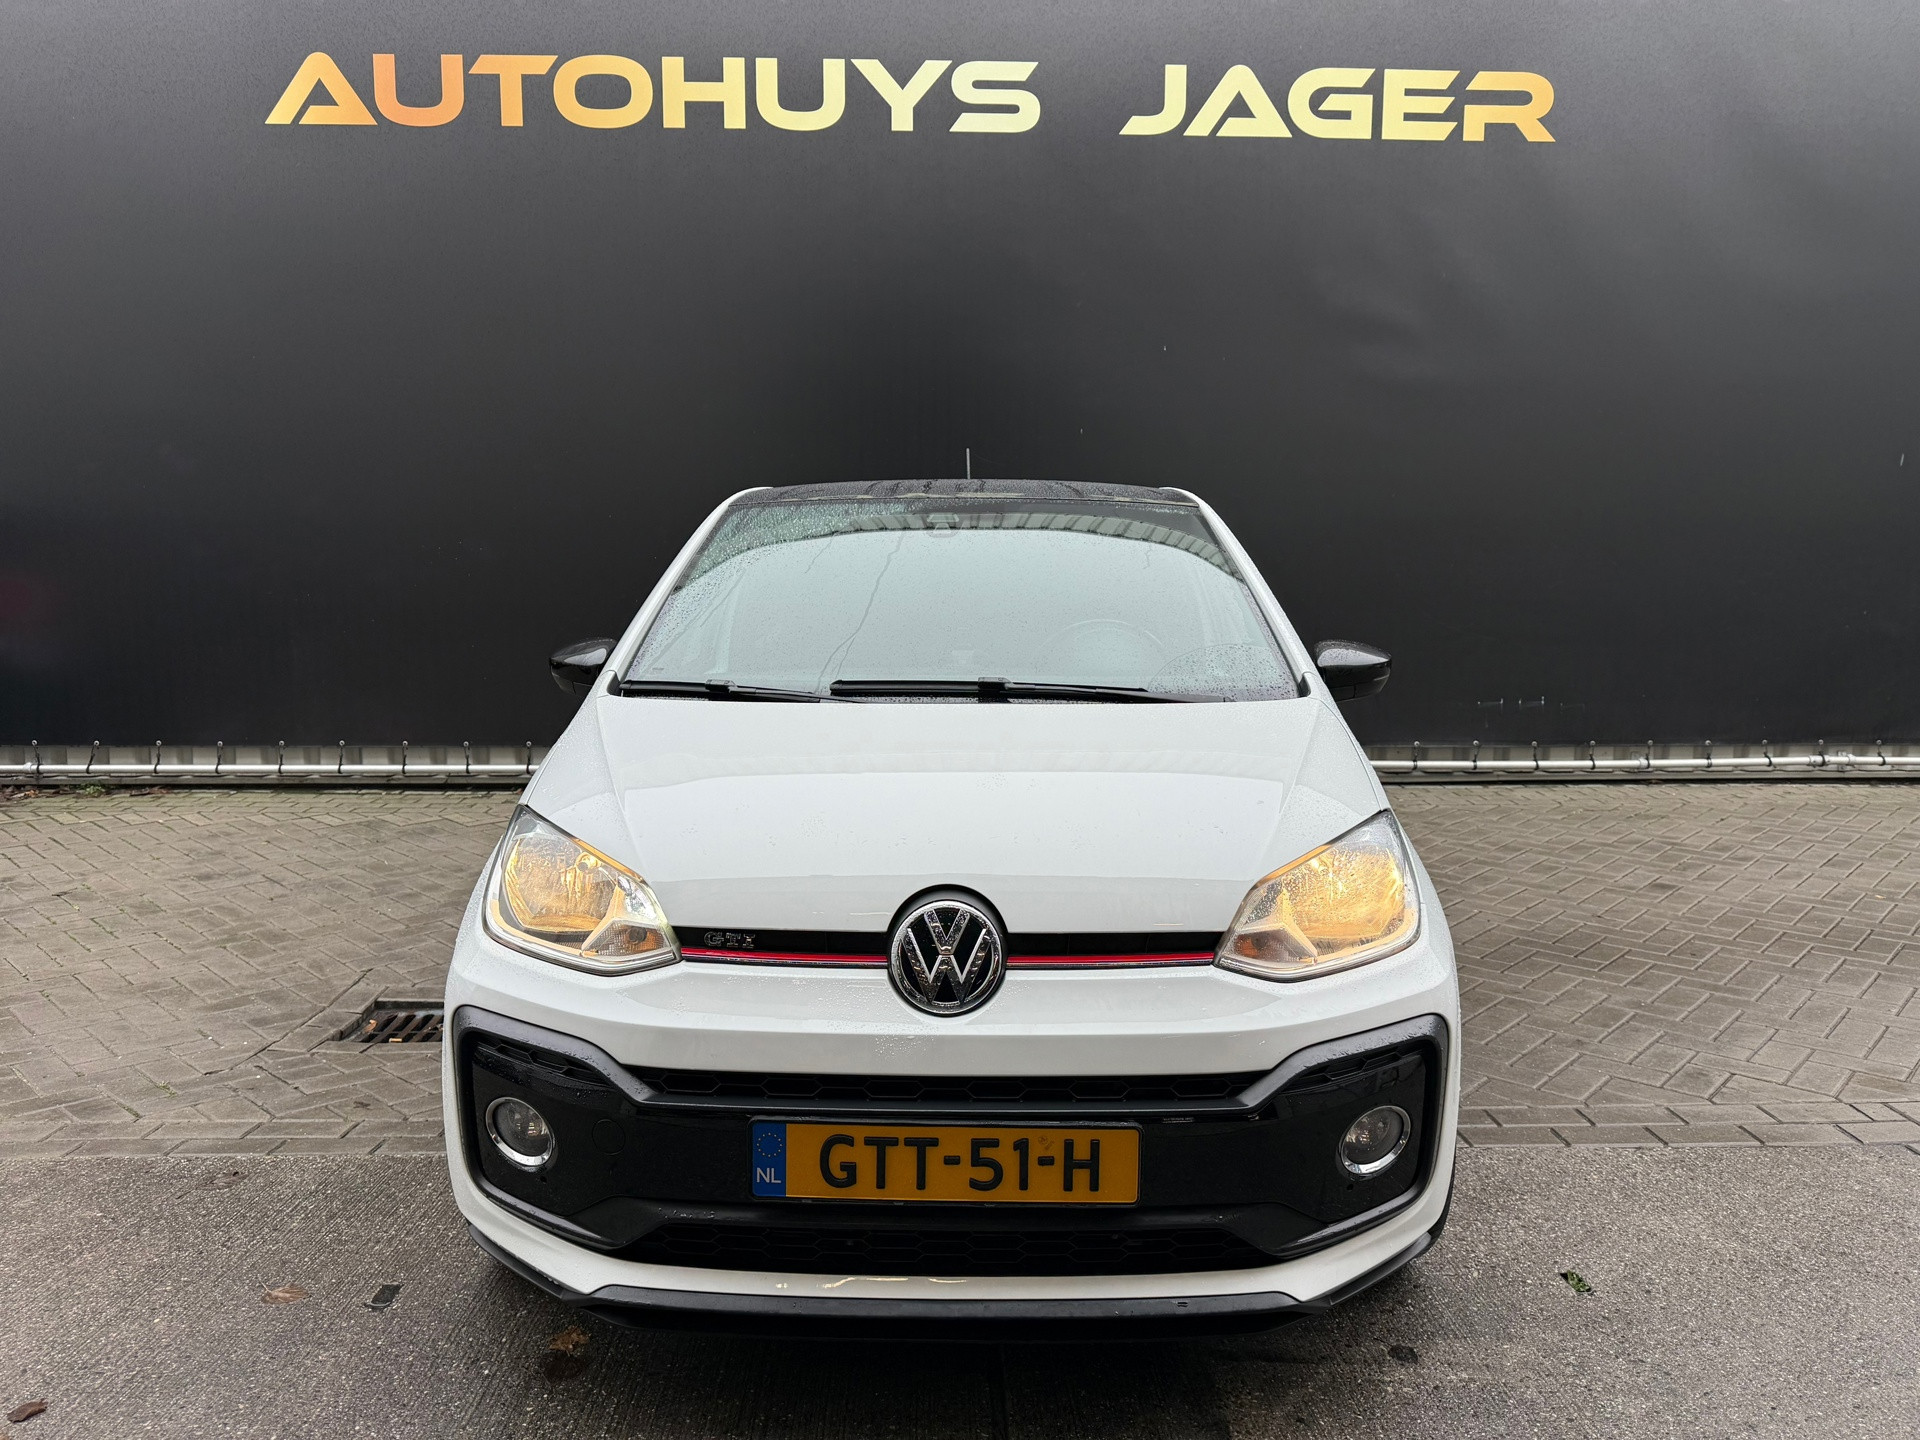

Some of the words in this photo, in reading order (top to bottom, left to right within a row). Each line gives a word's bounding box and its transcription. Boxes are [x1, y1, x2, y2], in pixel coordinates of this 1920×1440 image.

[265, 51, 1041, 133] AUTOHUYS
[1118, 64, 1556, 142] JAGER
[704, 931, 756, 948] GTI
[756, 1167, 782, 1184] NL
[819, 1134, 1101, 1192] GTT-51-H
